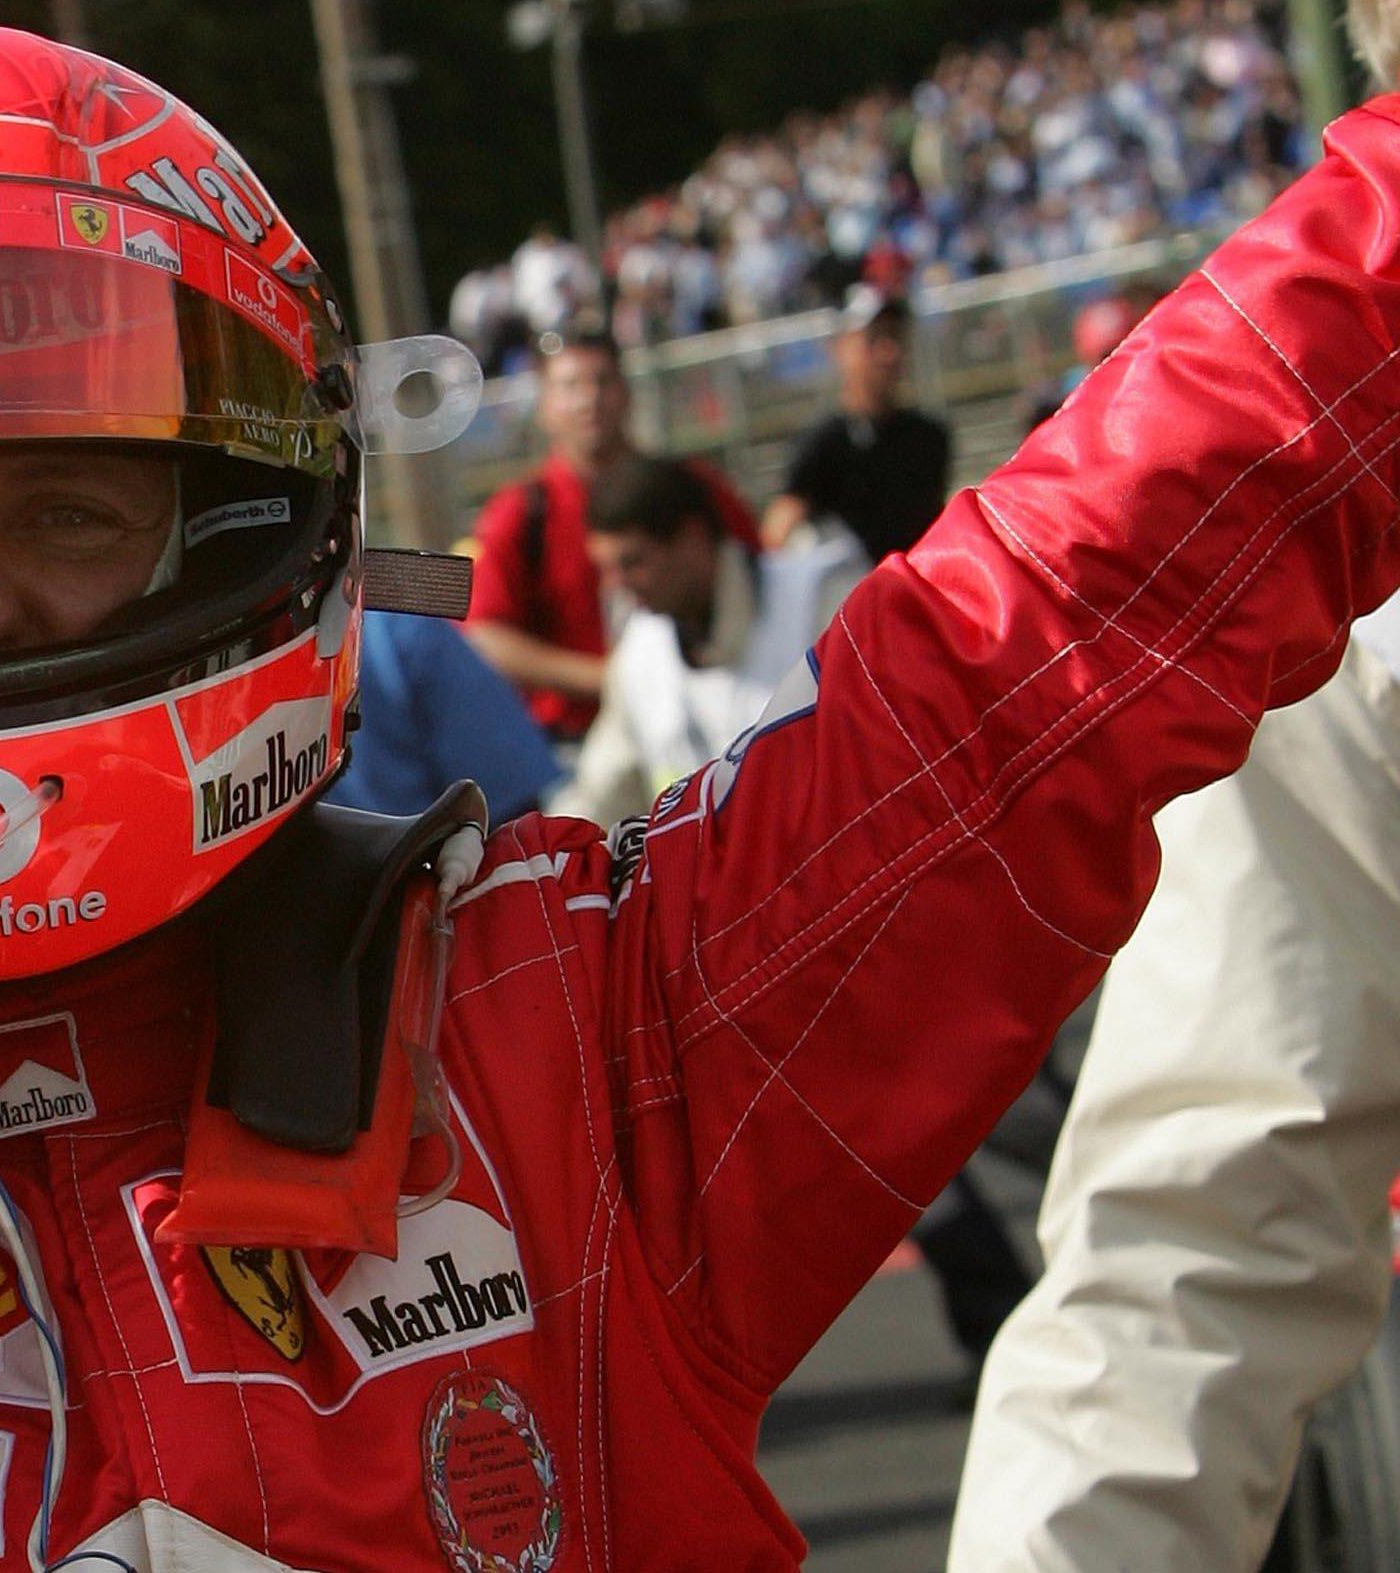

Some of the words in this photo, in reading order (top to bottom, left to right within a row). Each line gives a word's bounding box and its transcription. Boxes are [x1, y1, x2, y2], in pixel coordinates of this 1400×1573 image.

[125, 240, 180, 272] Marlboro
[235, 288, 302, 348] vodafone
[201, 729, 330, 845] Marlboro
[342, 1251, 528, 1358] Marlboro
